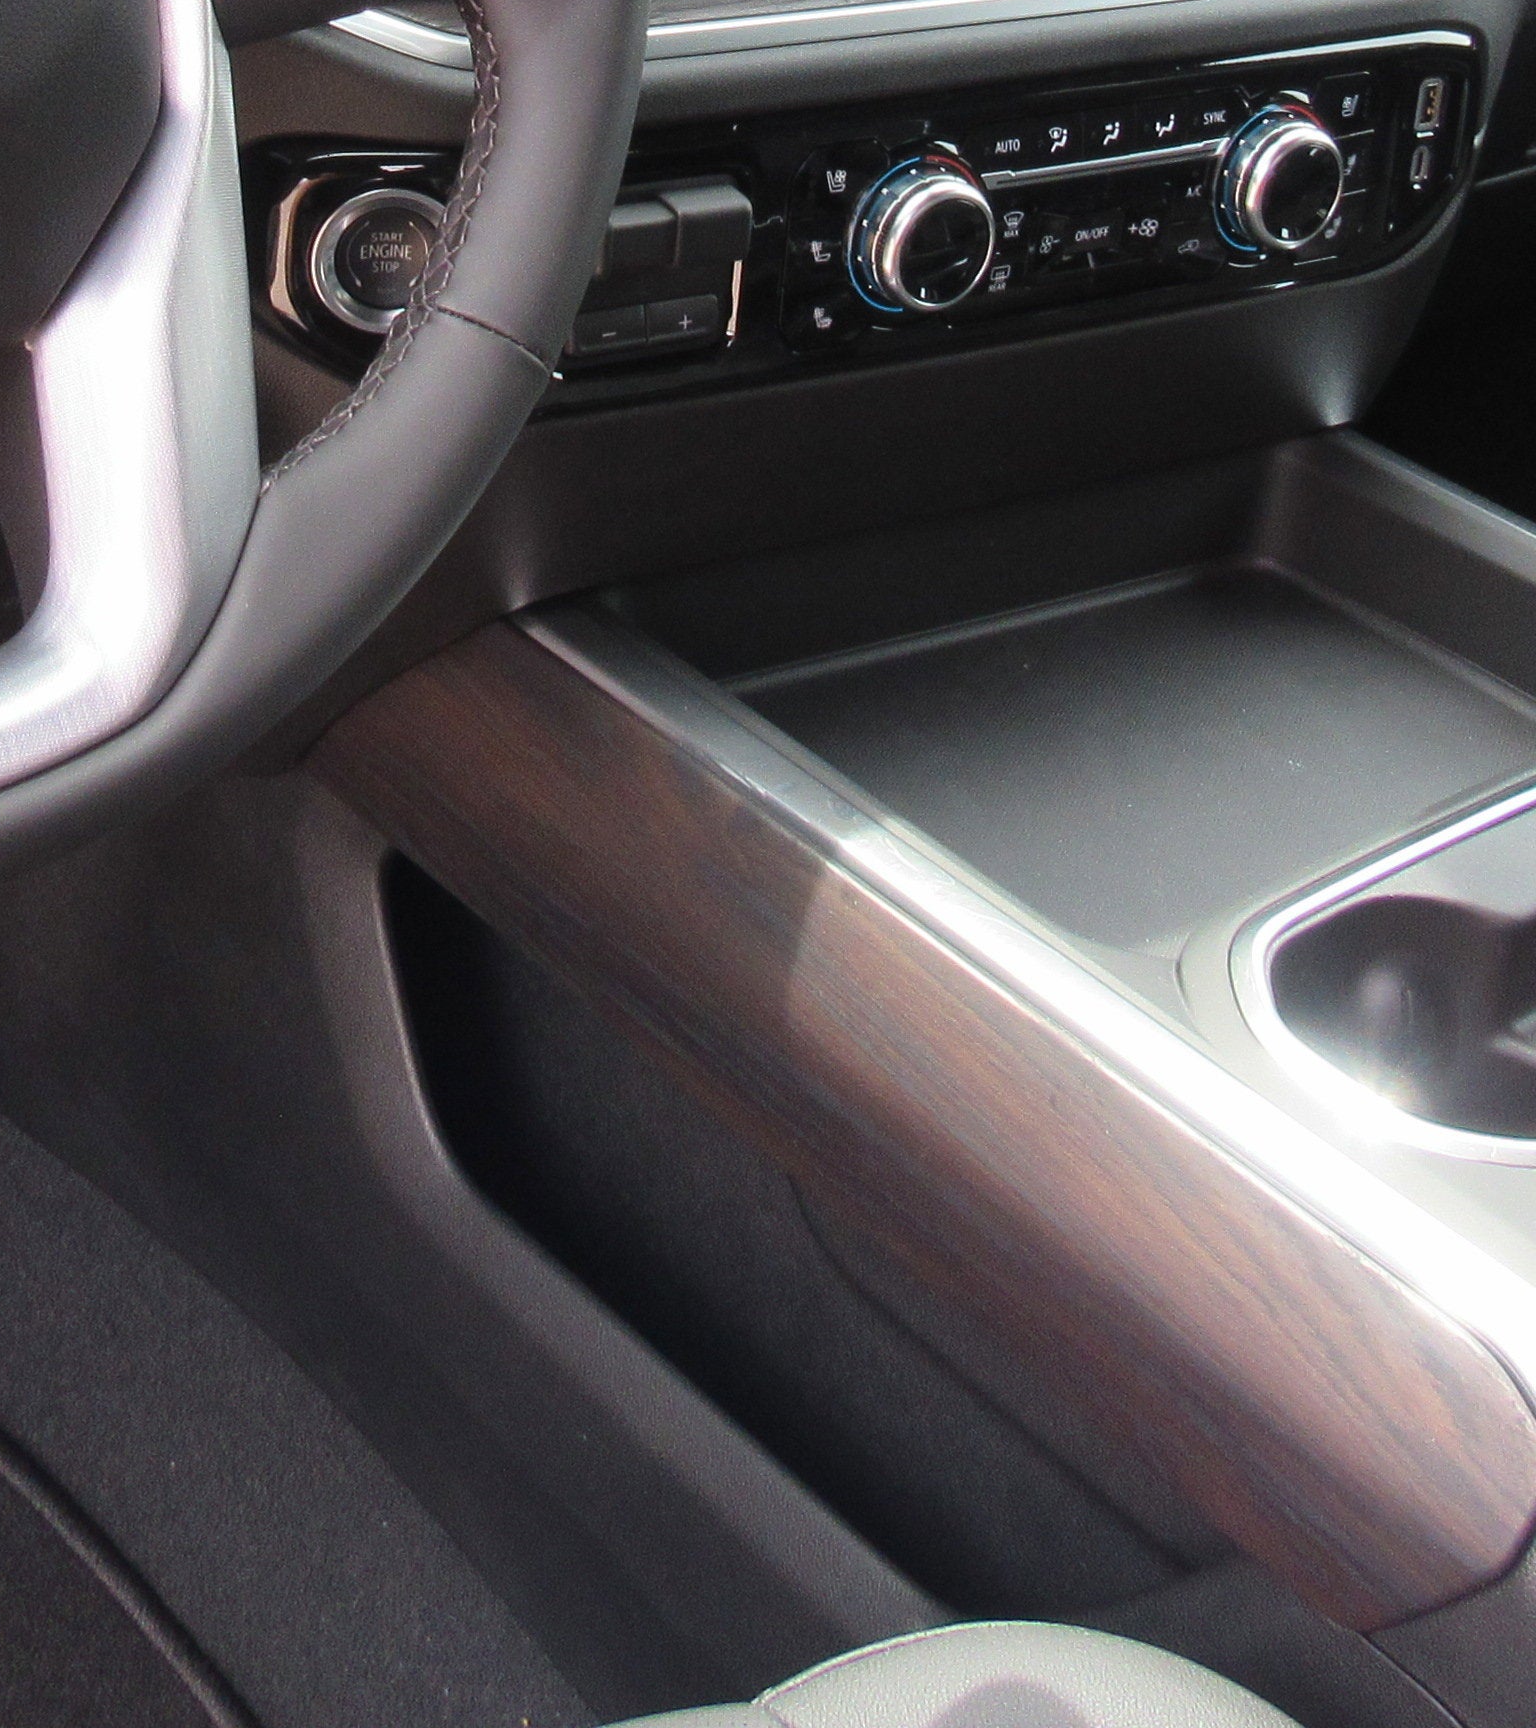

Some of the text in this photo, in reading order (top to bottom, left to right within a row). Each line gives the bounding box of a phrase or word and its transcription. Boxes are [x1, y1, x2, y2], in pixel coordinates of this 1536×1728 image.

[1203, 110, 1227, 124] SYNC
[994, 138, 1021, 154] AUTO
[1185, 184, 1202, 197] A/C
[371, 232, 404, 242] START
[1074, 225, 1111, 243] ON/OFF
[360, 244, 413, 261] ENGINE
[372, 260, 401, 273] STOP
